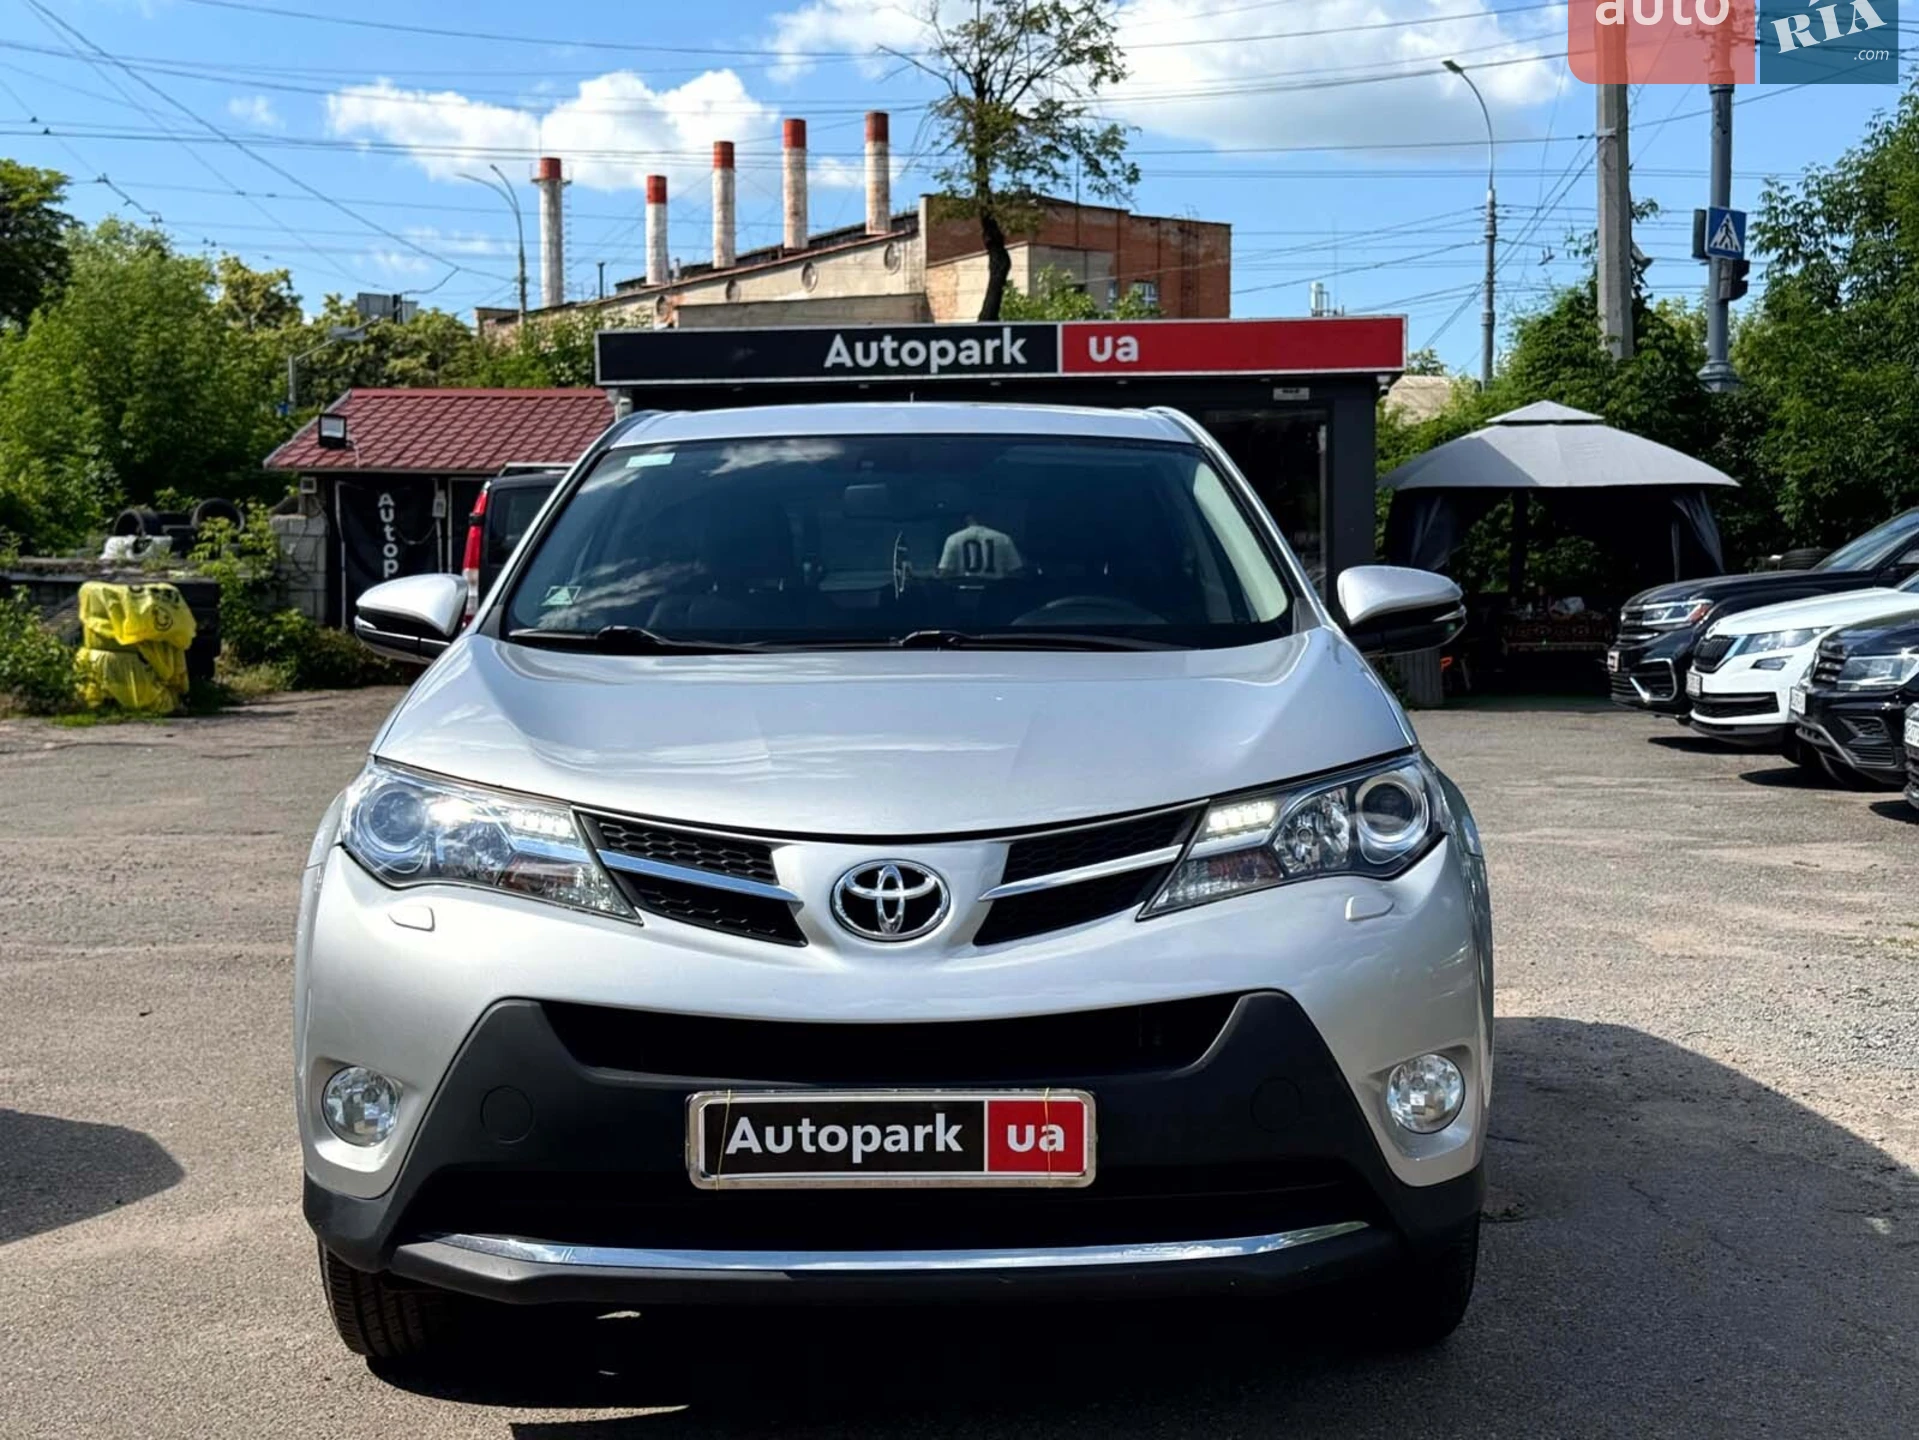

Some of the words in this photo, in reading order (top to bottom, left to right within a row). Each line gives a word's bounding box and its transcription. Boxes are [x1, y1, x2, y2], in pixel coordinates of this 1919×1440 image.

[824, 327, 1026, 374] Autopark
[1088, 334, 1139, 363] ua
[725, 1113, 962, 1163] Autopark
[1006, 1124, 1065, 1152] ua
